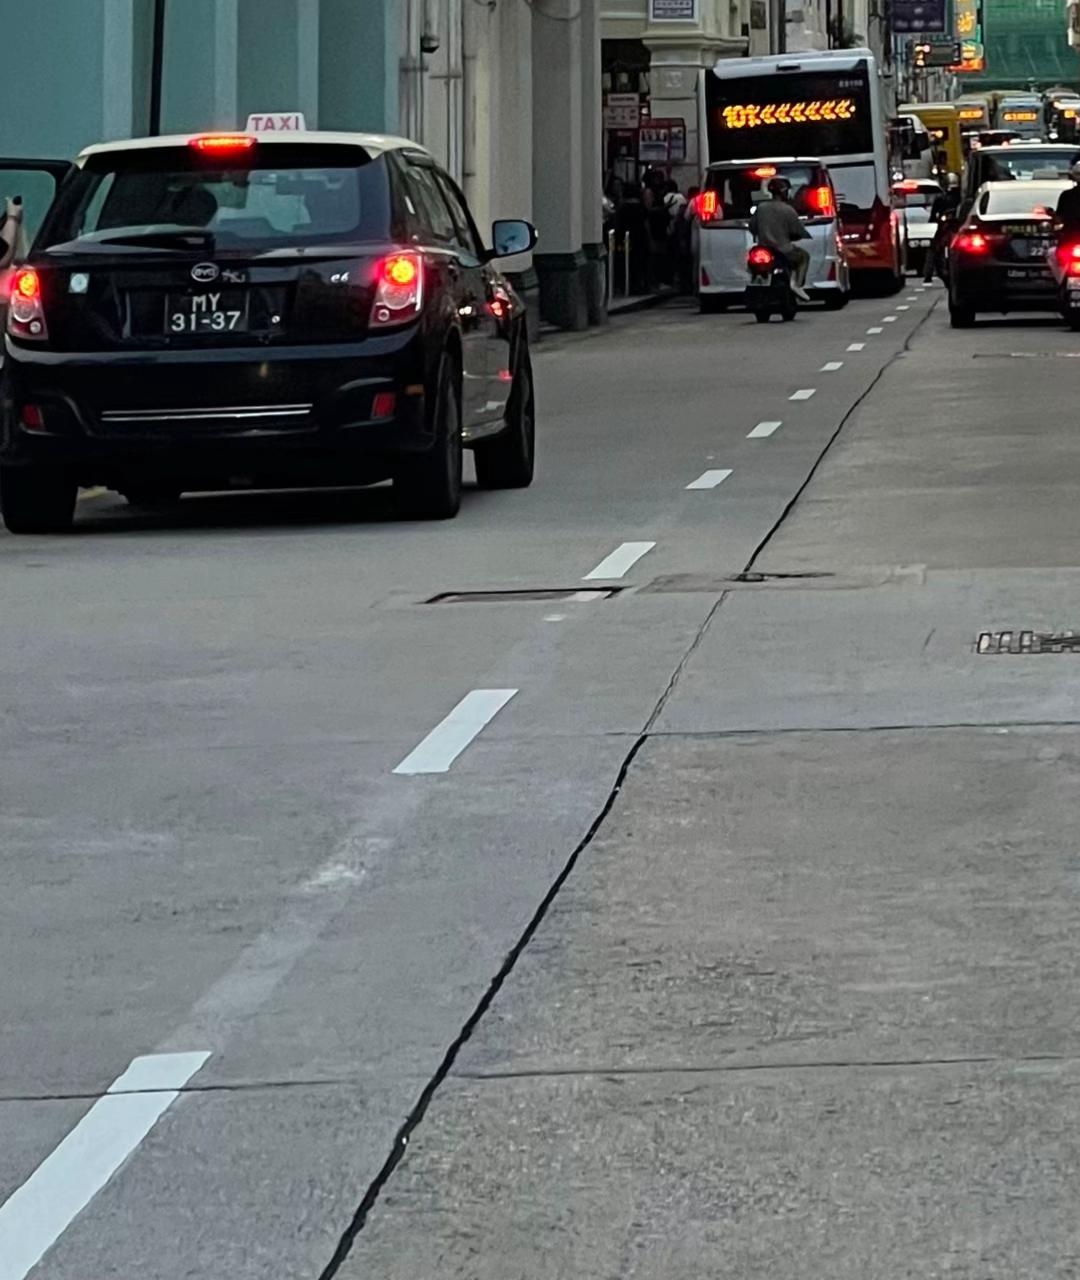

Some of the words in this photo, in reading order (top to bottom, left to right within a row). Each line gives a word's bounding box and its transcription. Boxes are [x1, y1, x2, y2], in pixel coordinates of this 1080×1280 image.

[252, 116, 299, 131] TAXI
[330, 271, 349, 283] e6
[192, 292, 220, 312] MY
[171, 311, 241, 331] 31-37
